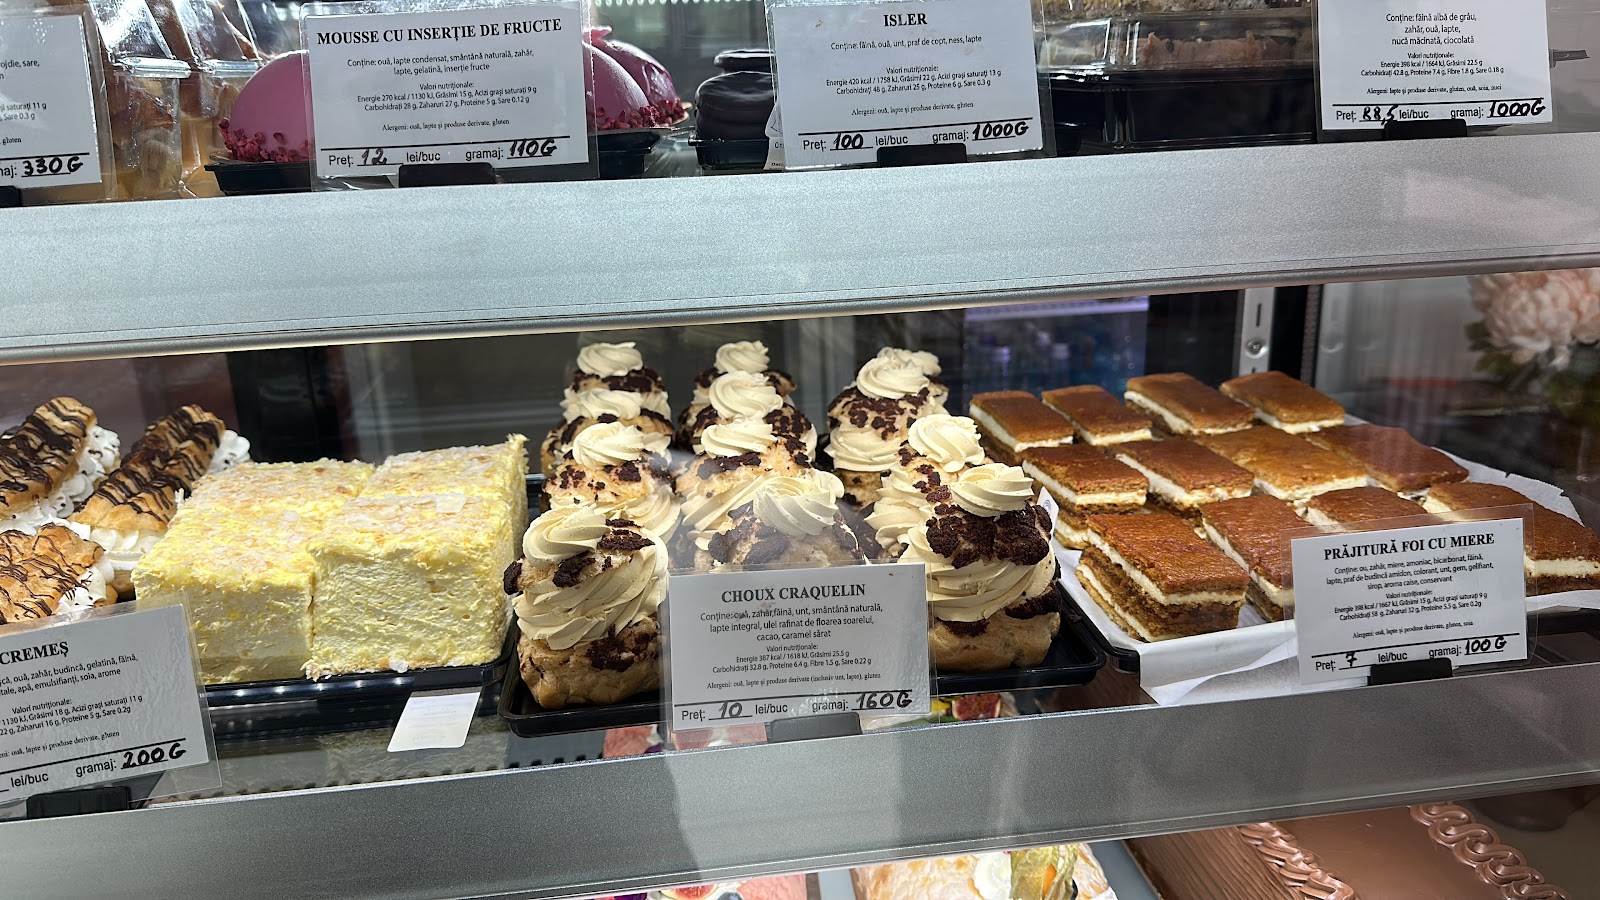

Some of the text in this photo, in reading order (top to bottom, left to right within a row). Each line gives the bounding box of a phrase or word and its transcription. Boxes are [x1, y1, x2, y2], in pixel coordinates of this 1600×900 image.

[883, 13, 928, 27] ISLER
[317, 19, 562, 45] MOUSSE CU INSERȚIE DE FRUCTE
[1336, 110, 1357, 123] Preț:
[1399, 109, 1429, 120] lei/buc
[1450, 107, 1484, 121] gramaj:
[803, 139, 827, 152] Preț:
[833, 132, 864, 150] 100
[876, 135, 909, 147] lei/buc
[932, 129, 969, 146] gramaj:
[329, 155, 354, 168] Preț:
[362, 148, 387, 165] 12
[406, 152, 441, 163] lei/buc
[465, 147, 504, 162] gramaj:
[1324, 533, 1495, 560] PRĂJITURĂ FOI CU MIERE
[722, 584, 865, 603] CHOUX CRAQUELIN
[0, 642, 69, 665] CREMEȘ
[1315, 660, 1336, 672] Preț:
[1378, 652, 1409, 664] lei/buc
[1428, 645, 1462, 662] gramaj:
[682, 710, 706, 722] Preț:
[719, 701, 743, 719] 10
[755, 704, 788, 715] lei/buc
[812, 699, 849, 715] gramaj:
[11, 773, 49, 788] lei/buc
[76, 759, 117, 777] gramaj:
